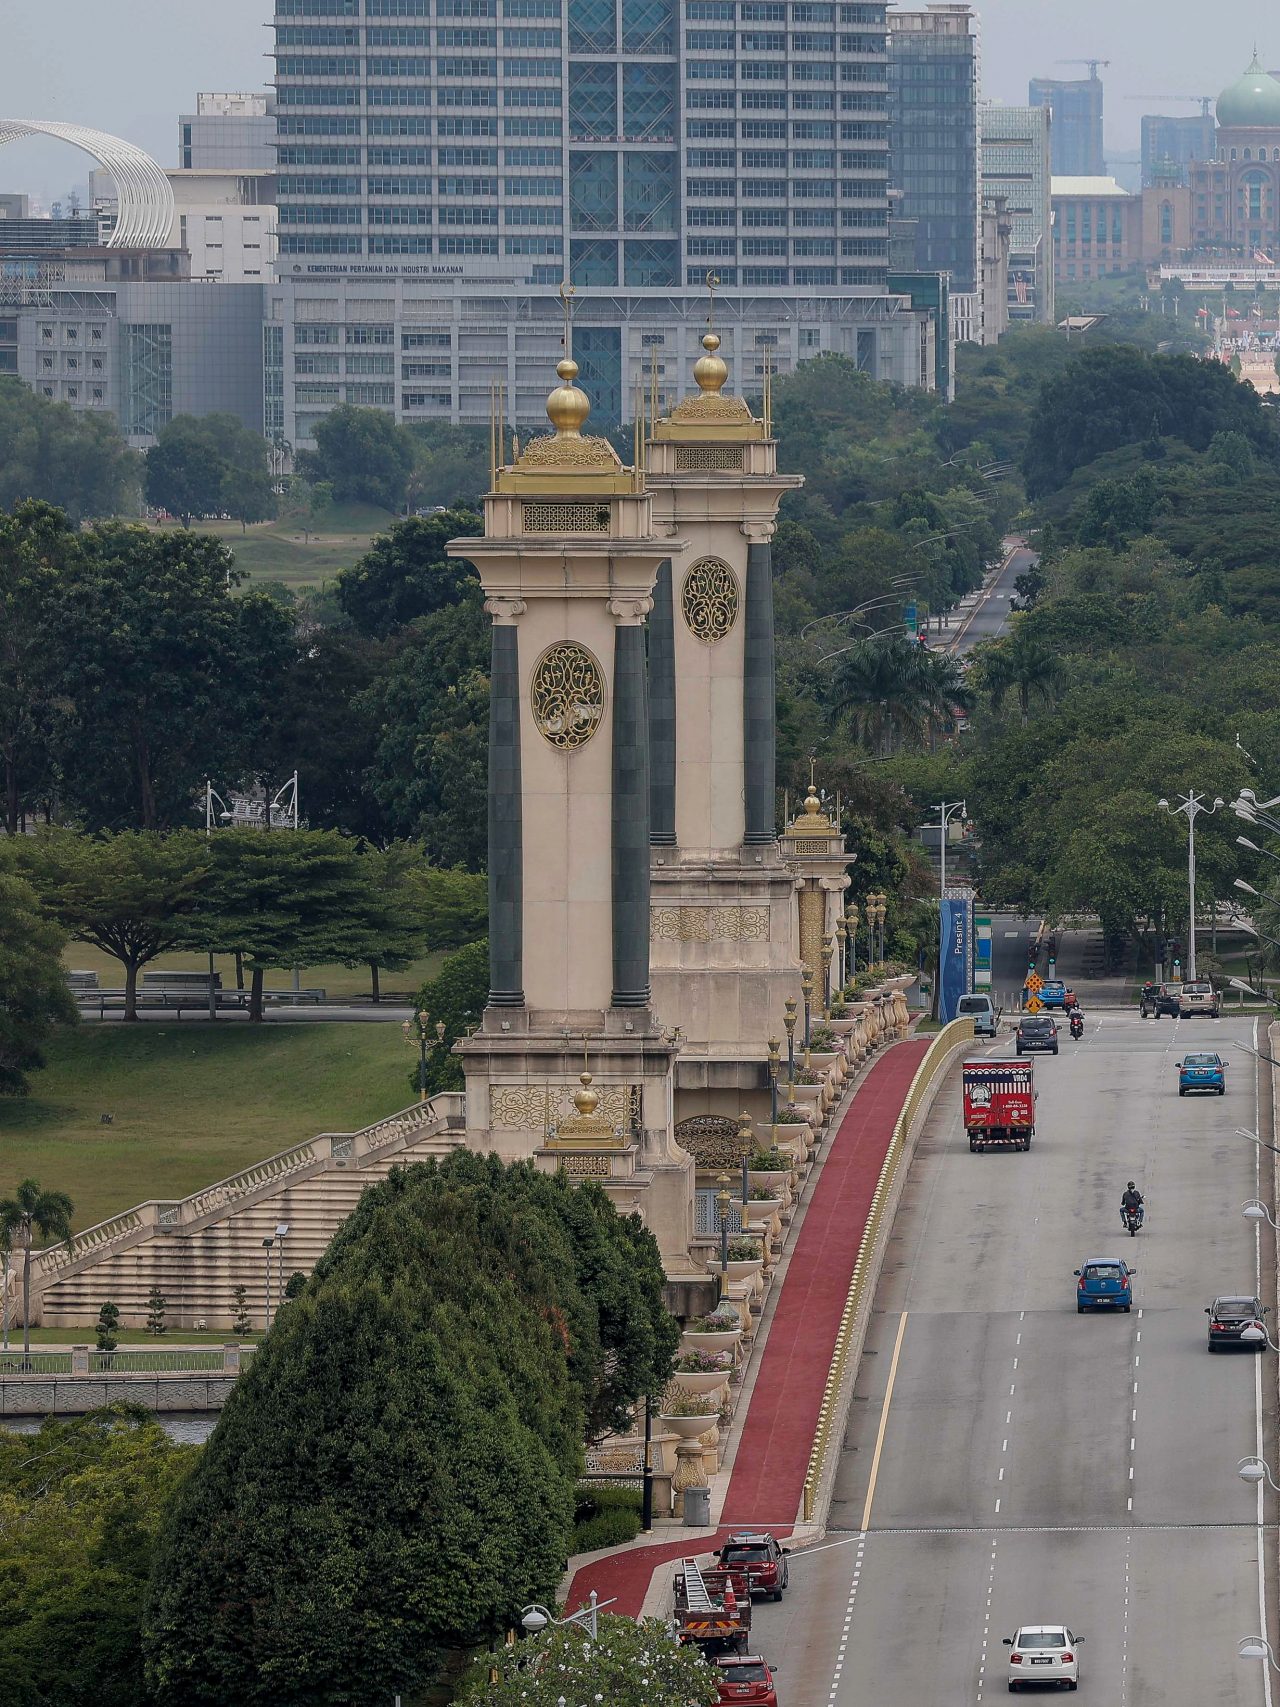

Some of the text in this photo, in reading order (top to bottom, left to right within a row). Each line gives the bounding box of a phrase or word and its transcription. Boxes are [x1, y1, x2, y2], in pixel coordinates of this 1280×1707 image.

[307, 265, 464, 273] KEMENTERIAN PERTANIAN DAN INDUSTRI MAKANAN
[954, 921, 963, 954] Presint
